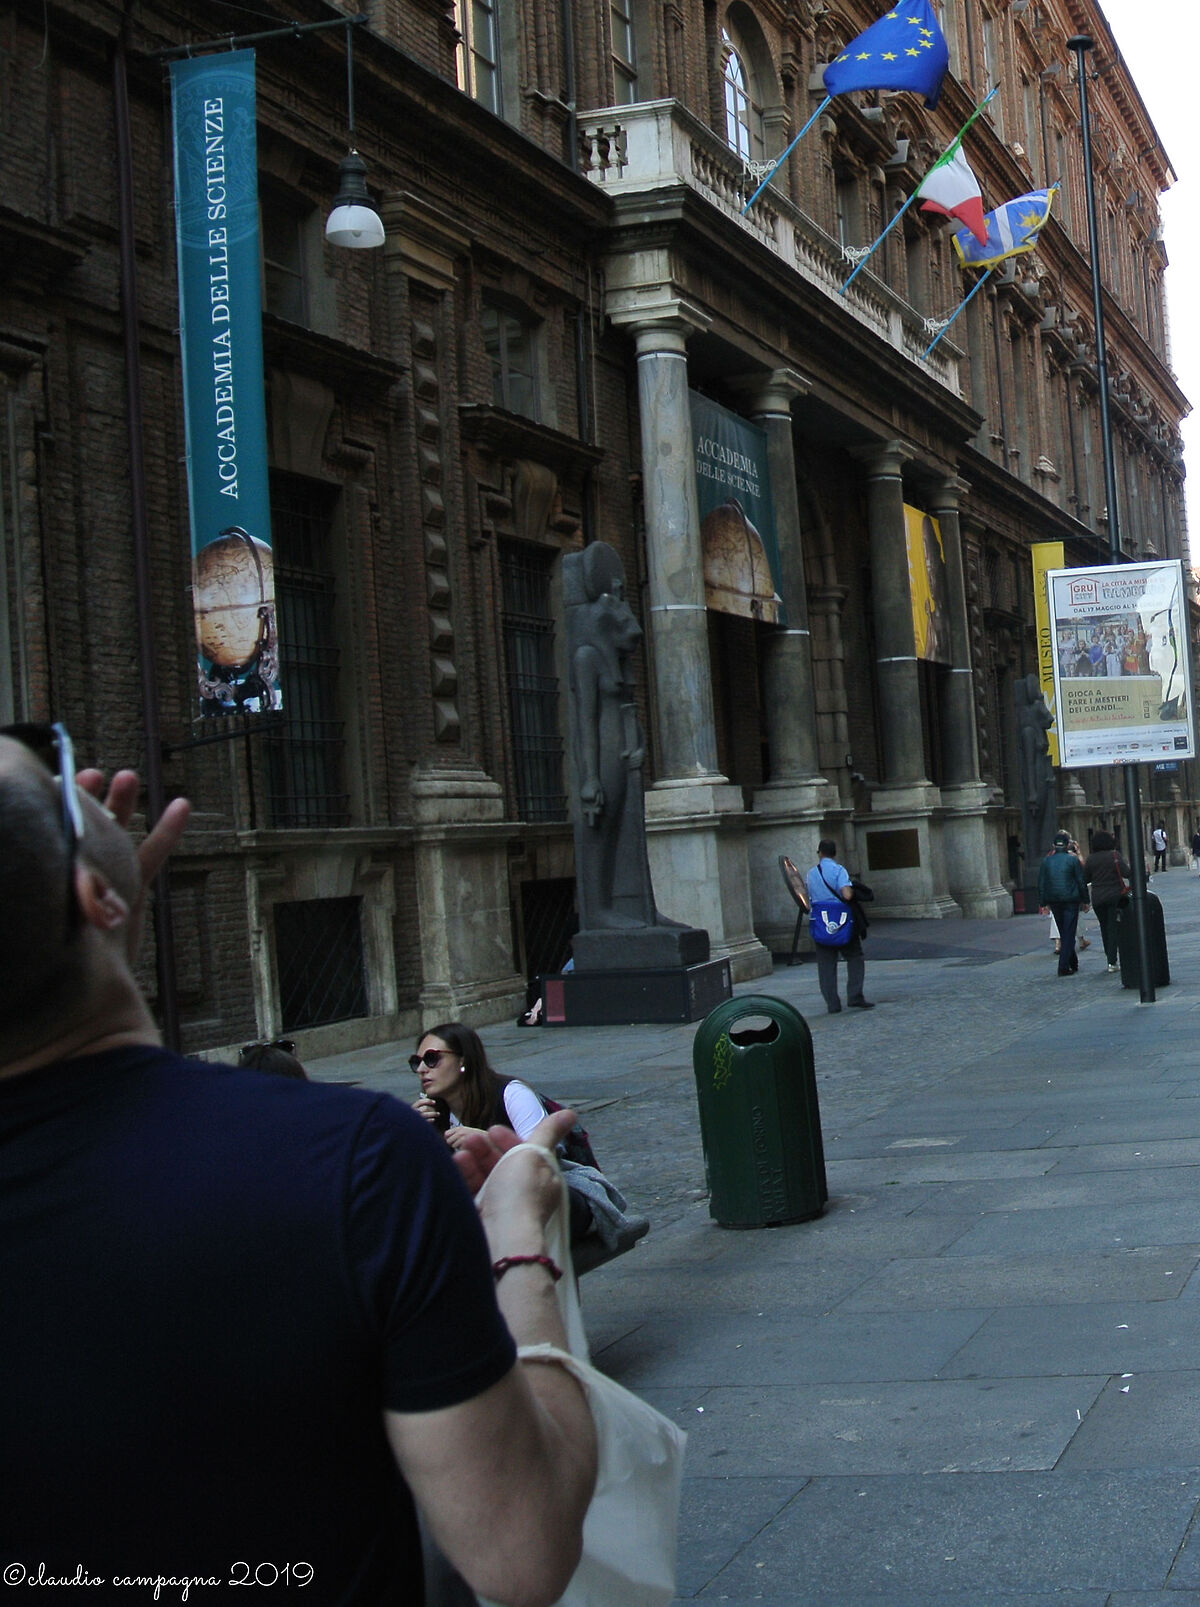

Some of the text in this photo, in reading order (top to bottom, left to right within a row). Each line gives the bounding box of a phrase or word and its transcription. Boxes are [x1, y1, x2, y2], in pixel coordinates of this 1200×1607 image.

[205, 97, 238, 499] ACCADEMIA DELLE SCIENZE
[697, 436, 759, 478] ACCADEMIA
[696, 459, 760, 498] DELLE SCIENZE
[1073, 585, 1094, 593] GRU
[1074, 592, 1093, 600] CITY
[1096, 604, 1121, 612] MAGGIO
[1040, 627, 1053, 683] MUSEO
[1068, 690, 1094, 698] GIOCA
[1095, 695, 1129, 704] MESTIERI
[1069, 706, 1082, 714] DEI
